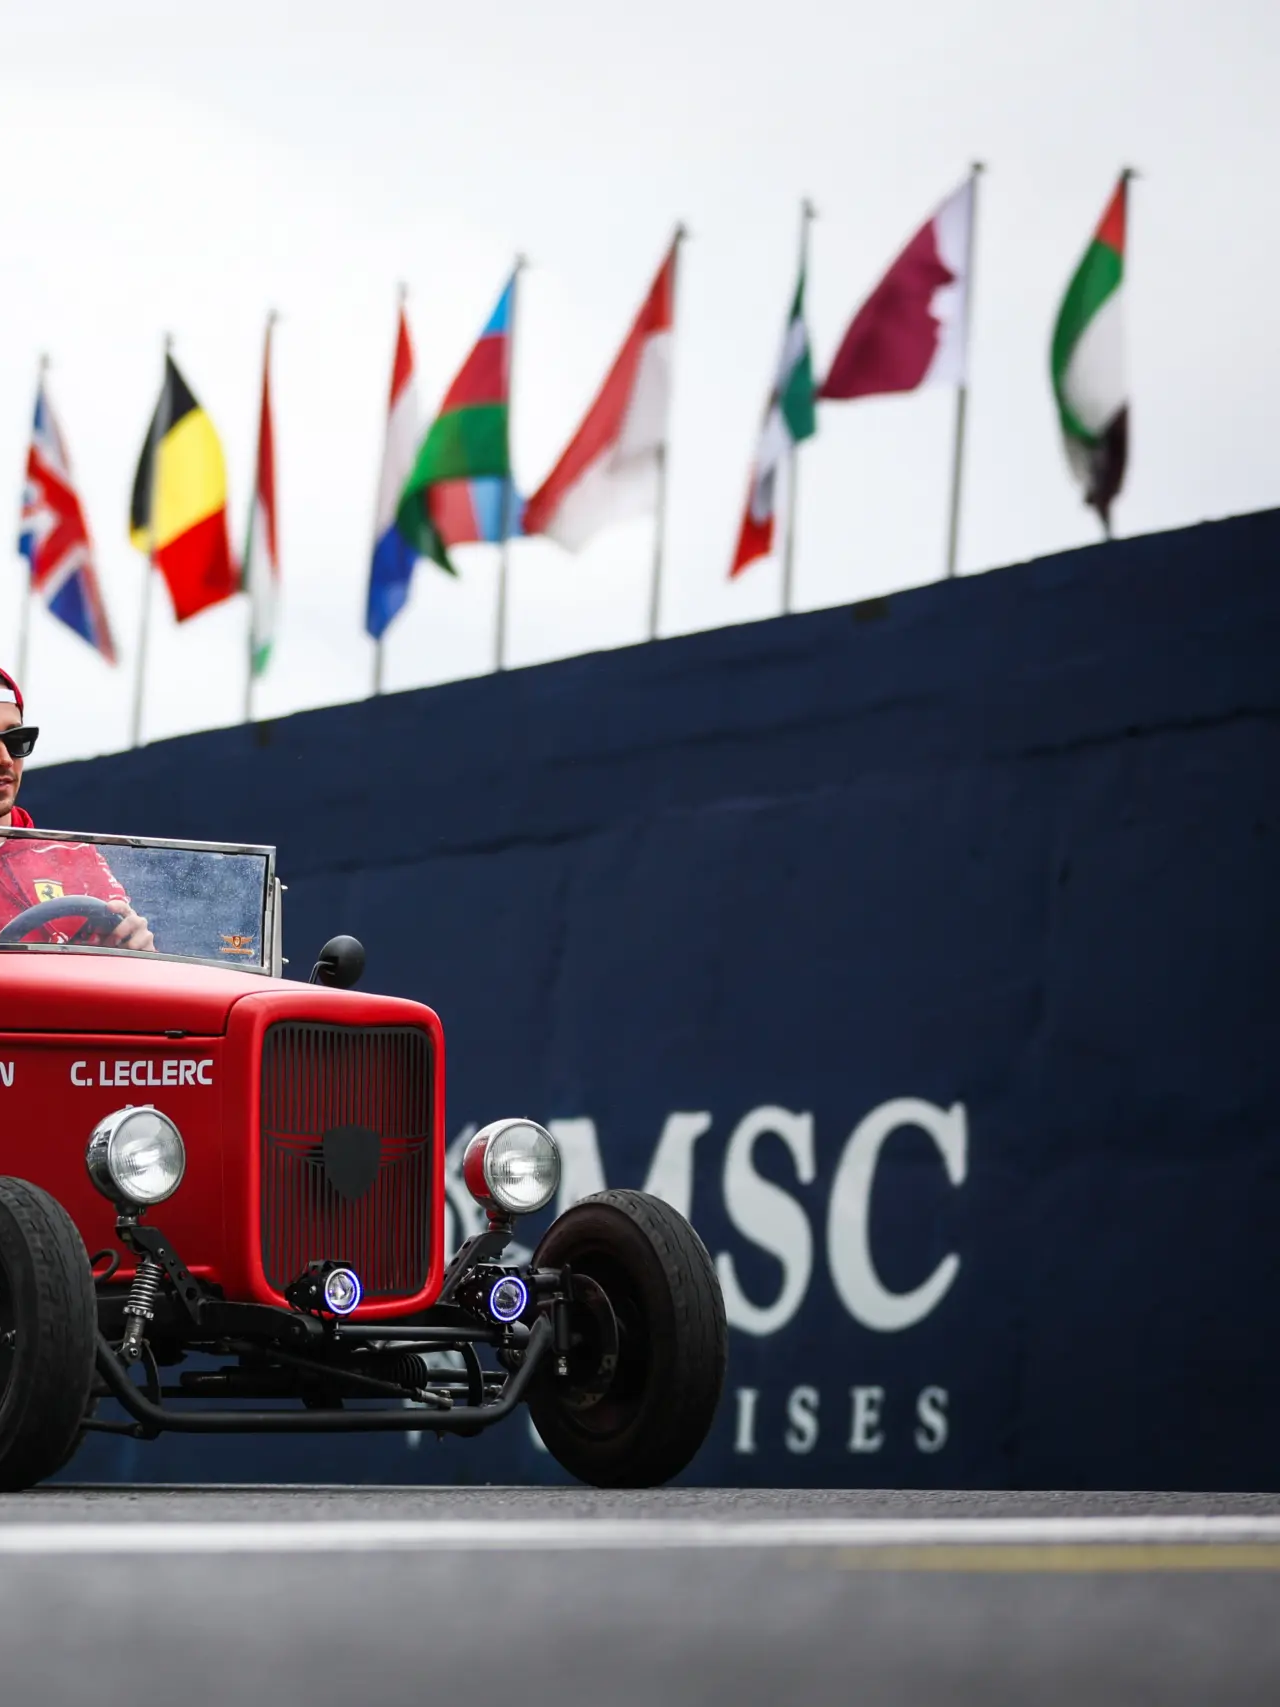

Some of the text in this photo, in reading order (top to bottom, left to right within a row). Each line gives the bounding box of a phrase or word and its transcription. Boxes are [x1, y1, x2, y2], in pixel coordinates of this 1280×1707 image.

[70, 1059, 214, 1086] C. LECLERC
[734, 1386, 949, 1454] ISES
